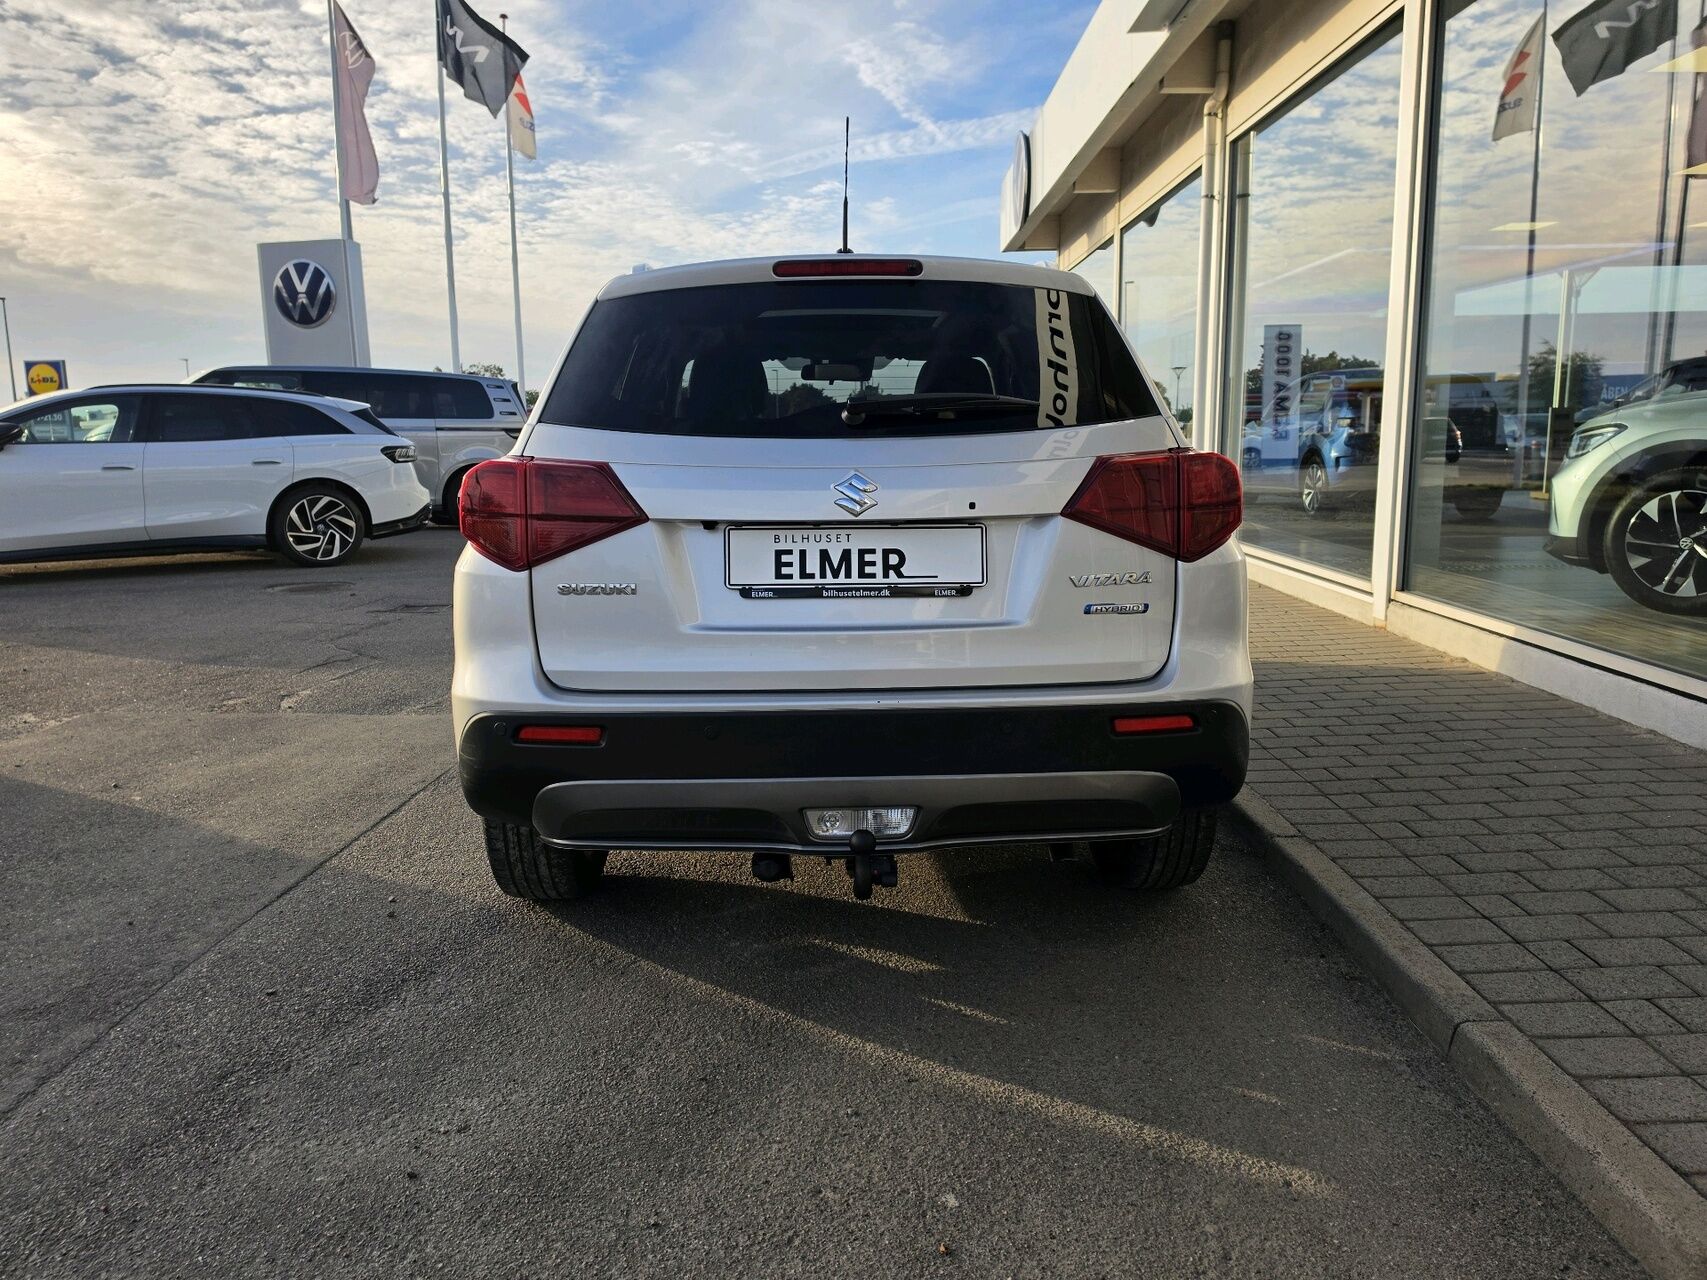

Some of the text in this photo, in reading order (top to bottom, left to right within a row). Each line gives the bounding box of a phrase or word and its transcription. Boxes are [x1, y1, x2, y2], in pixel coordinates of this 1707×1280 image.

[773, 533, 852, 544] BILHUSET
[774, 548, 938, 580] ELMER
[1068, 571, 1152, 588] VITARA
[557, 583, 637, 596] SUZUKI
[822, 589, 891, 598] bilhusetelmer.dk
[1095, 604, 1142, 613] HYBRID
